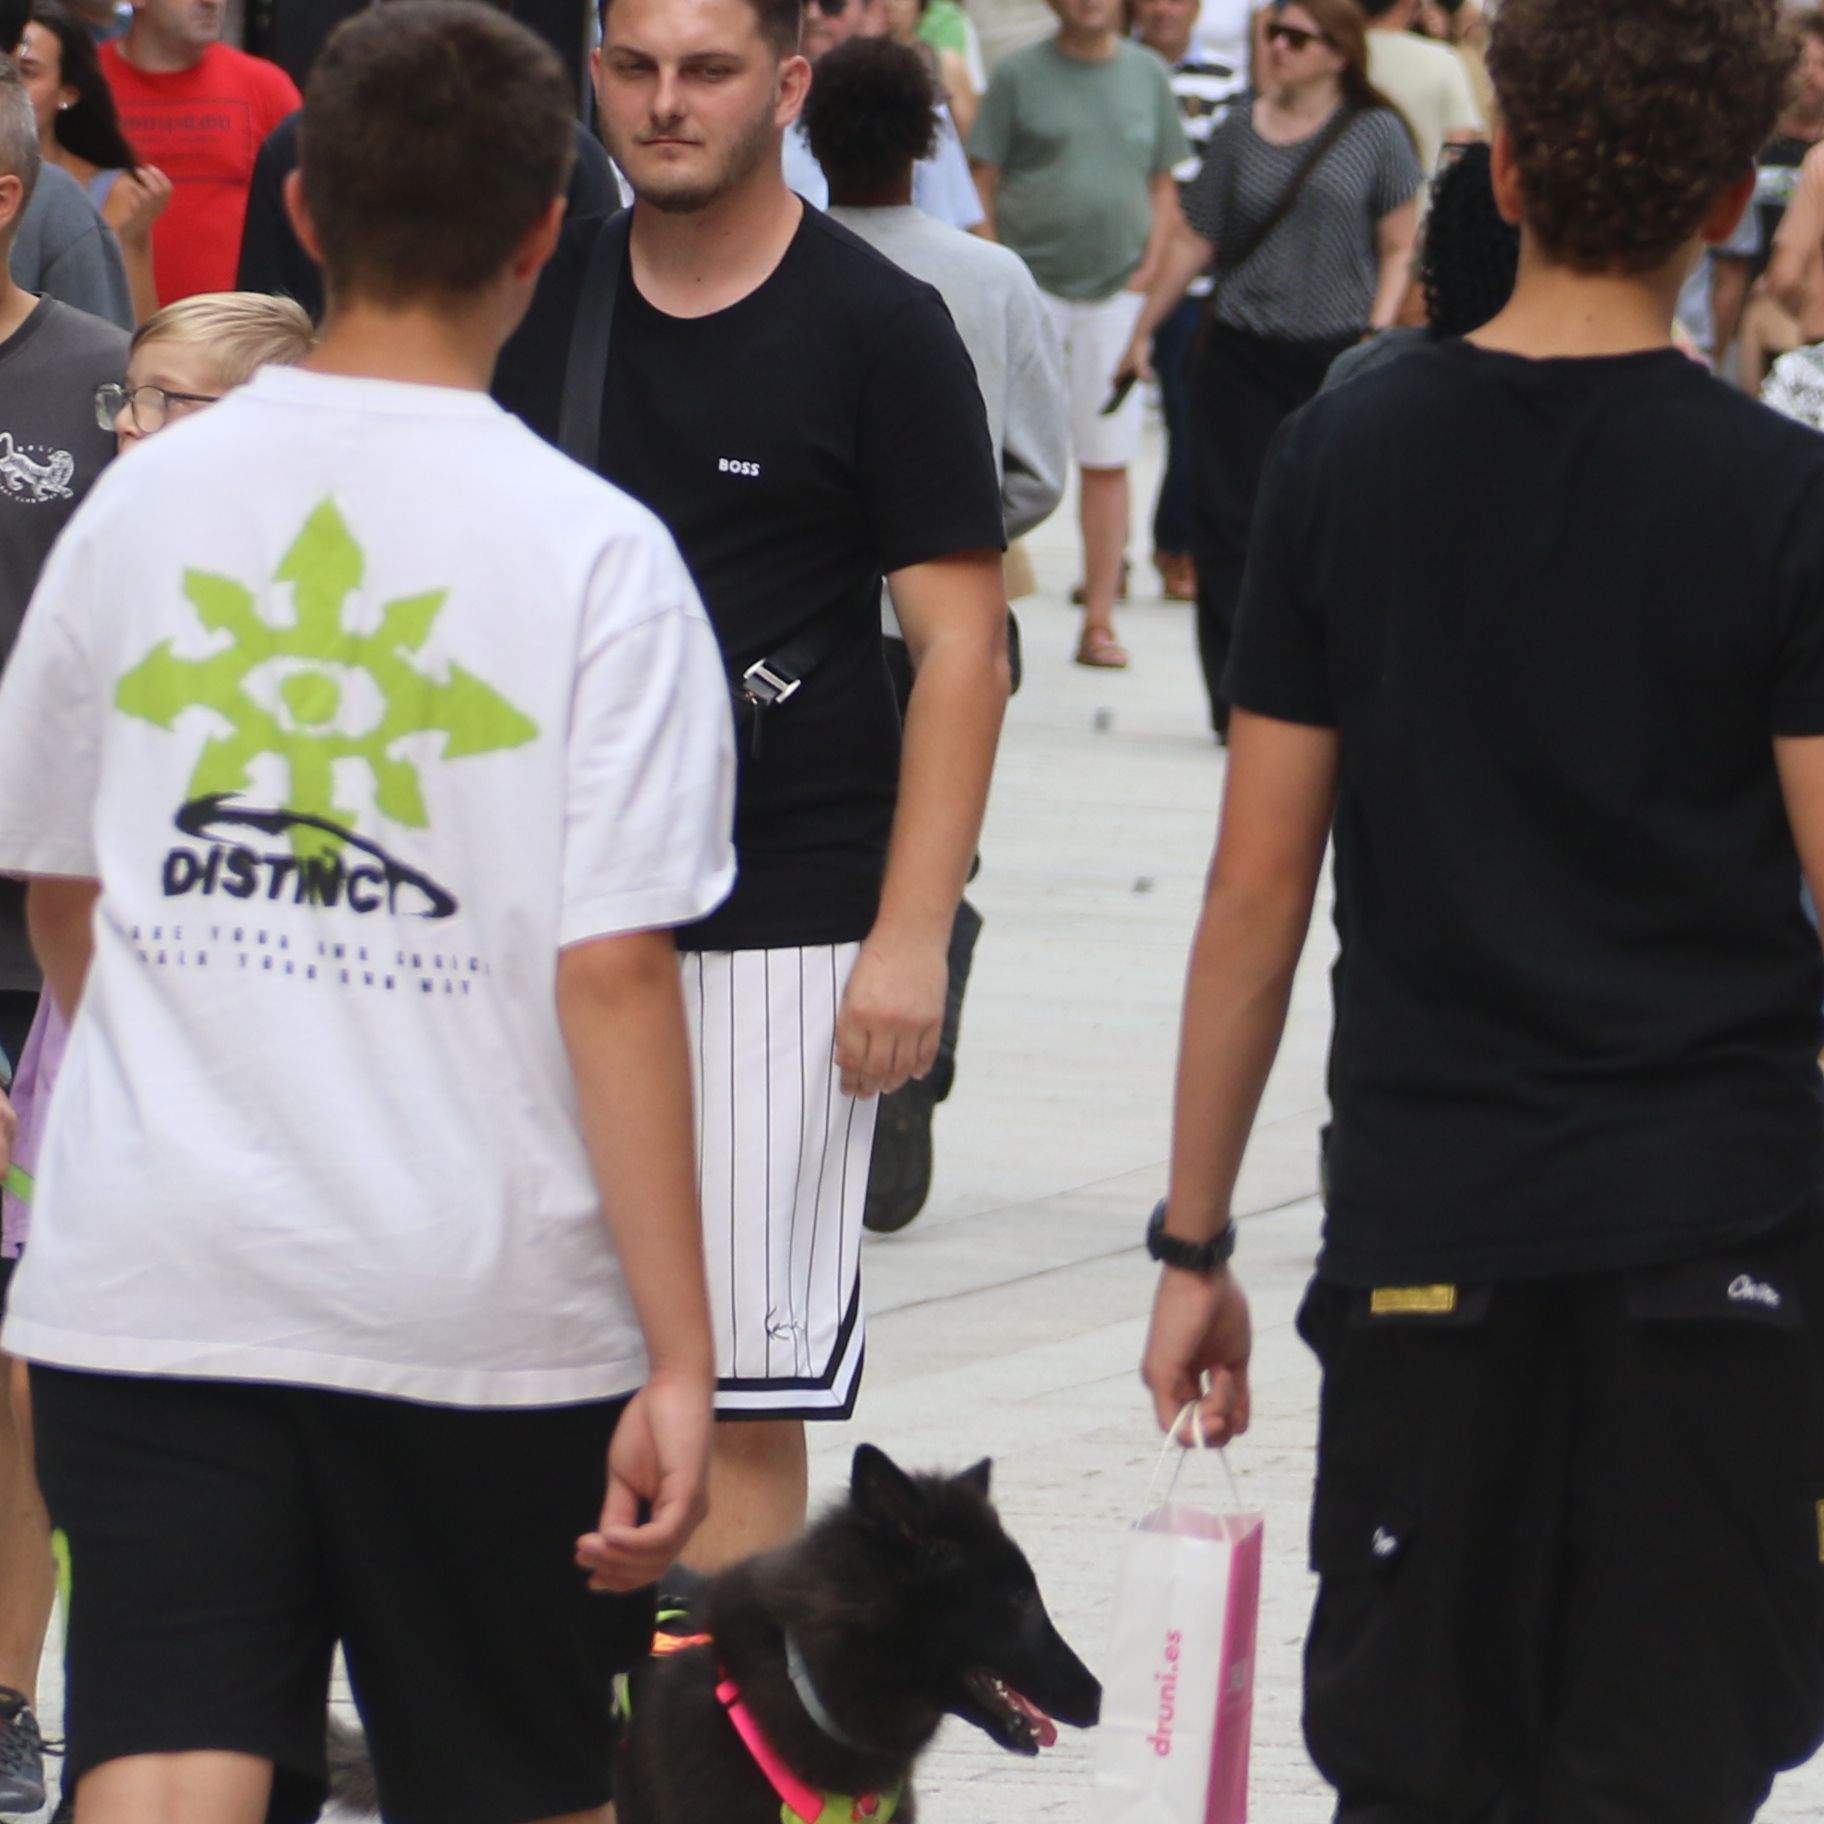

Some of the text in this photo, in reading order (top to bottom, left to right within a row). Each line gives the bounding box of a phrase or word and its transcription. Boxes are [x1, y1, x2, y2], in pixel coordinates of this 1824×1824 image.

[717, 456, 761, 478] BOSS
[161, 836, 458, 920] DISTINCT
[1146, 1628, 1183, 1758] druni.es
